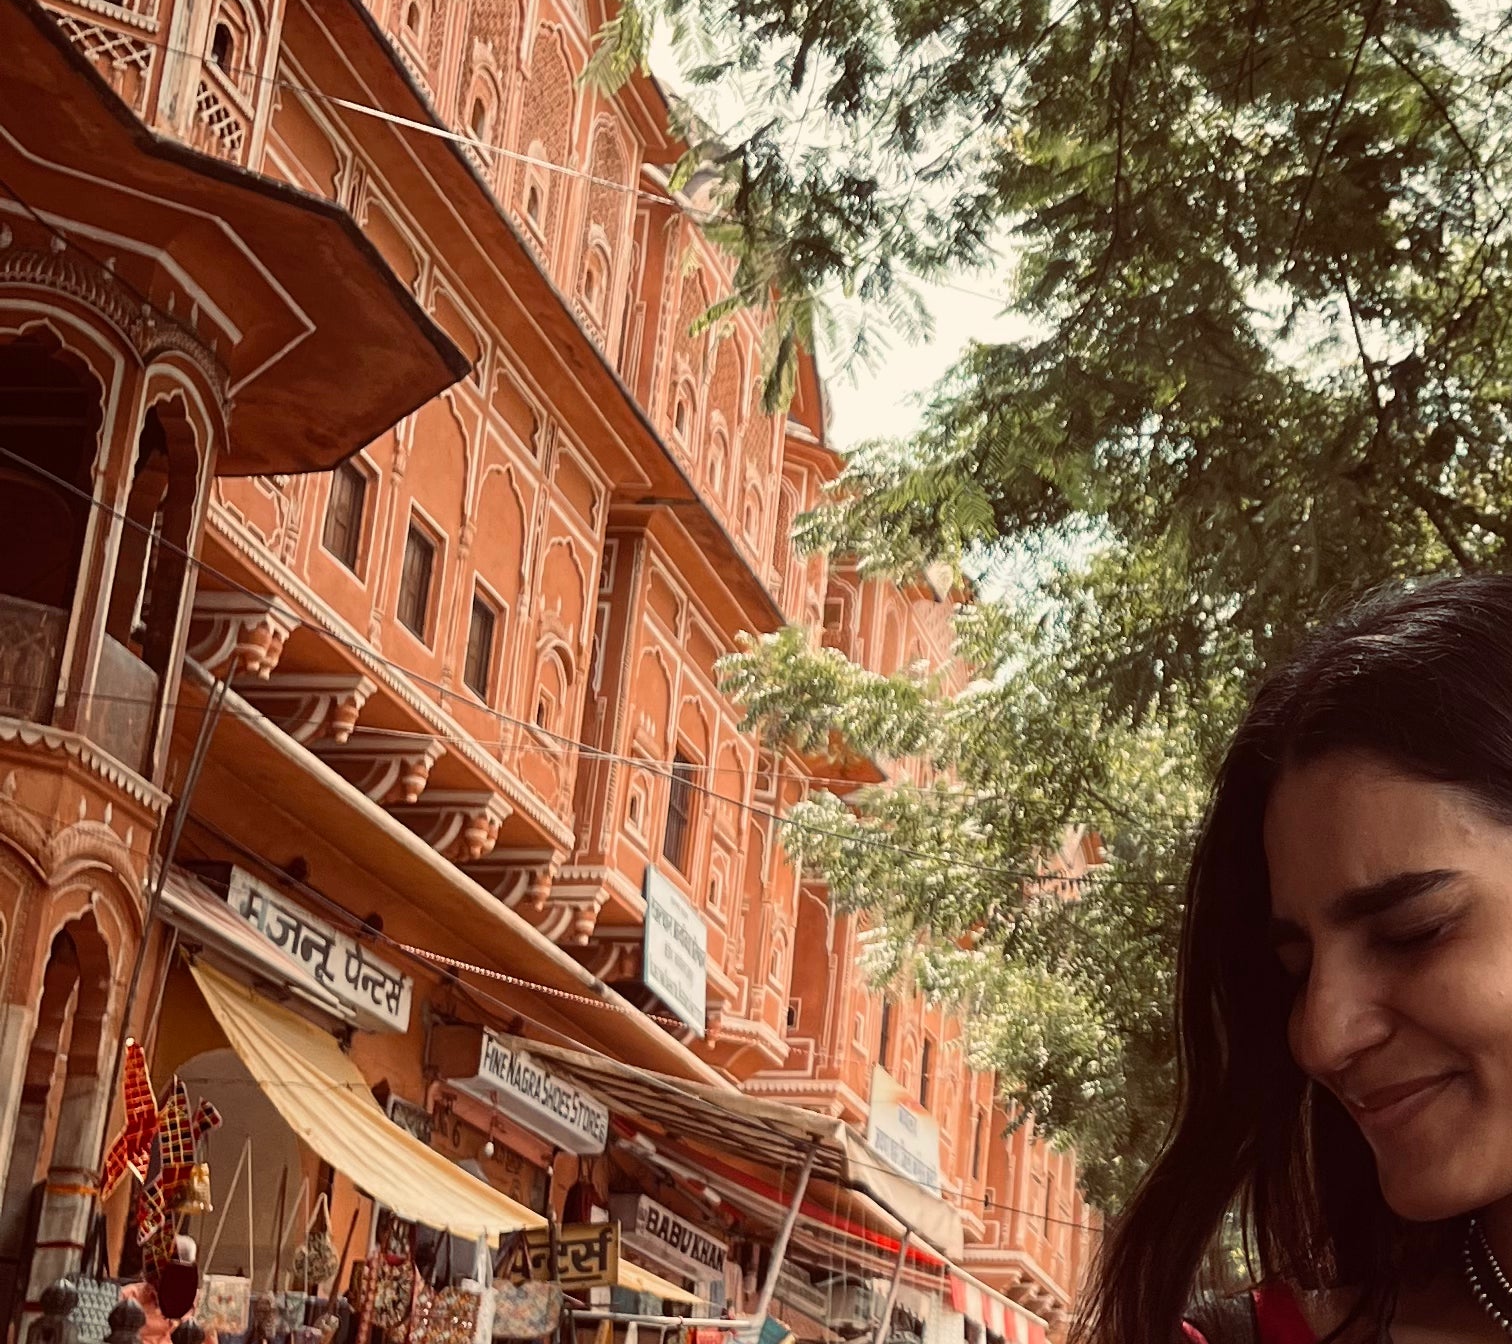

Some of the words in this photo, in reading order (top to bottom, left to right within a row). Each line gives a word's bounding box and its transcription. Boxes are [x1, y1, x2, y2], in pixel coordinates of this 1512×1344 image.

[484, 1036, 508, 1080] FINE
[506, 1051, 542, 1100] NAGRA
[541, 1071, 571, 1120] SHOES
[569, 1090, 601, 1138] STORE
